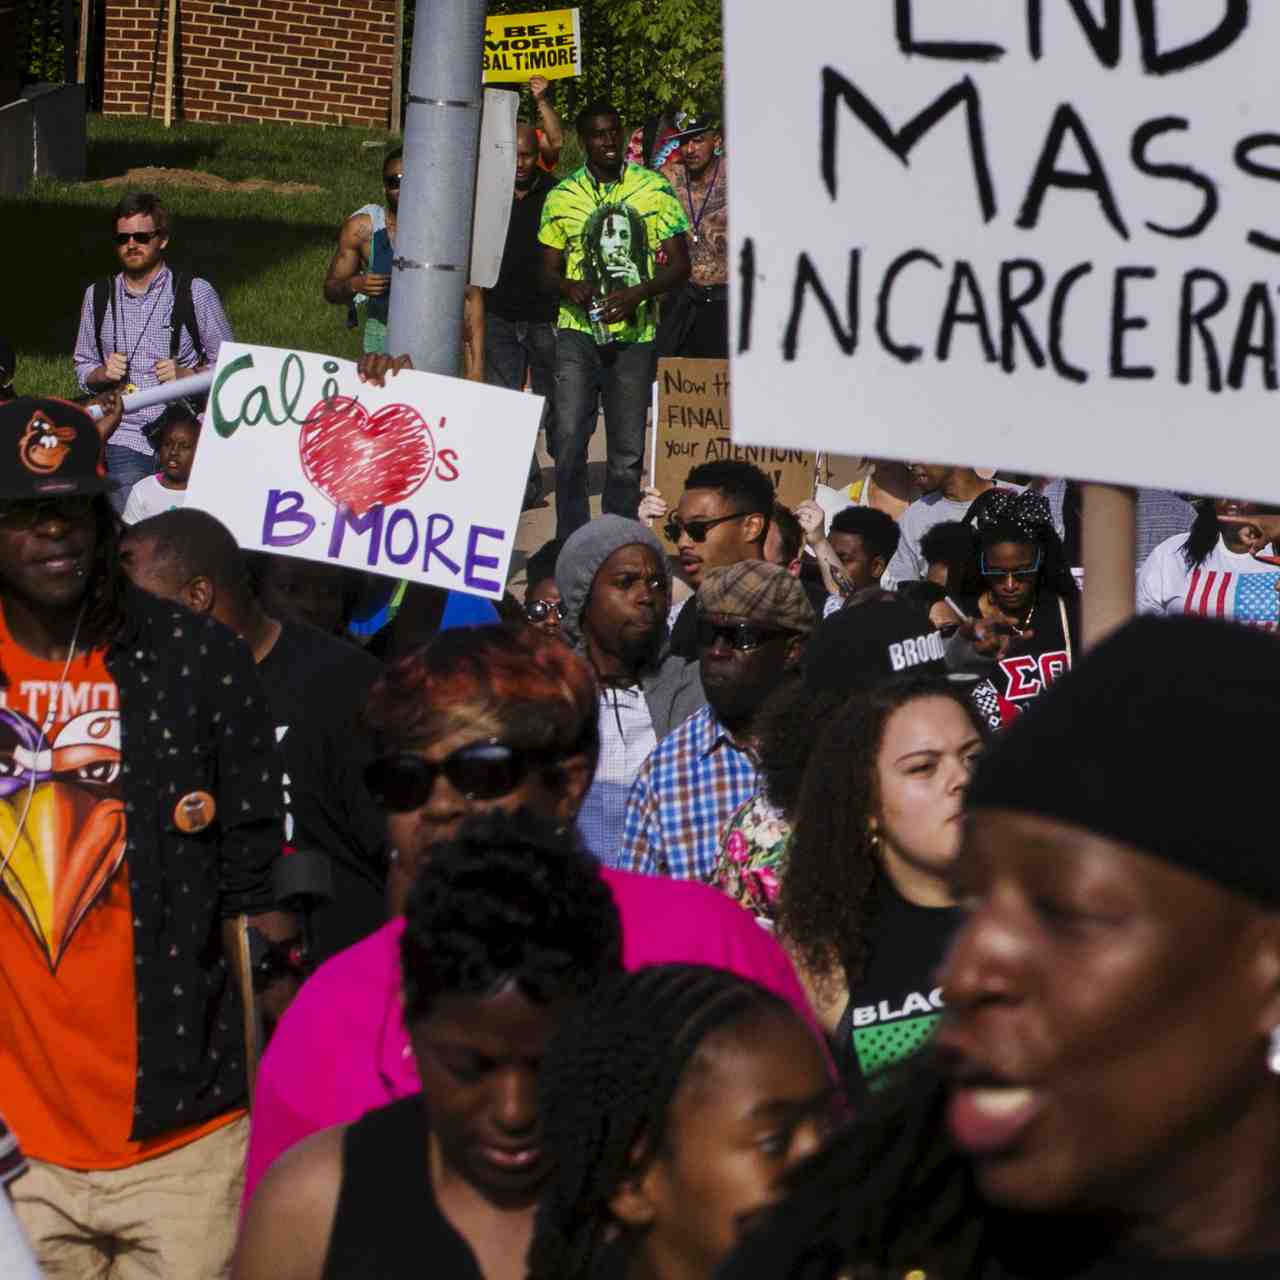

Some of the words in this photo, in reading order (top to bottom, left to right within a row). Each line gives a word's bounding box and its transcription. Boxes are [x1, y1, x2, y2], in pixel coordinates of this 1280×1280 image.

[503, 23, 547, 37] BE
[482, 33, 574, 51] MORE
[480, 46, 577, 72] BALTIMORE
[663, 368, 706, 395] Now
[210, 353, 358, 438] Cali
[665, 438, 700, 459] your
